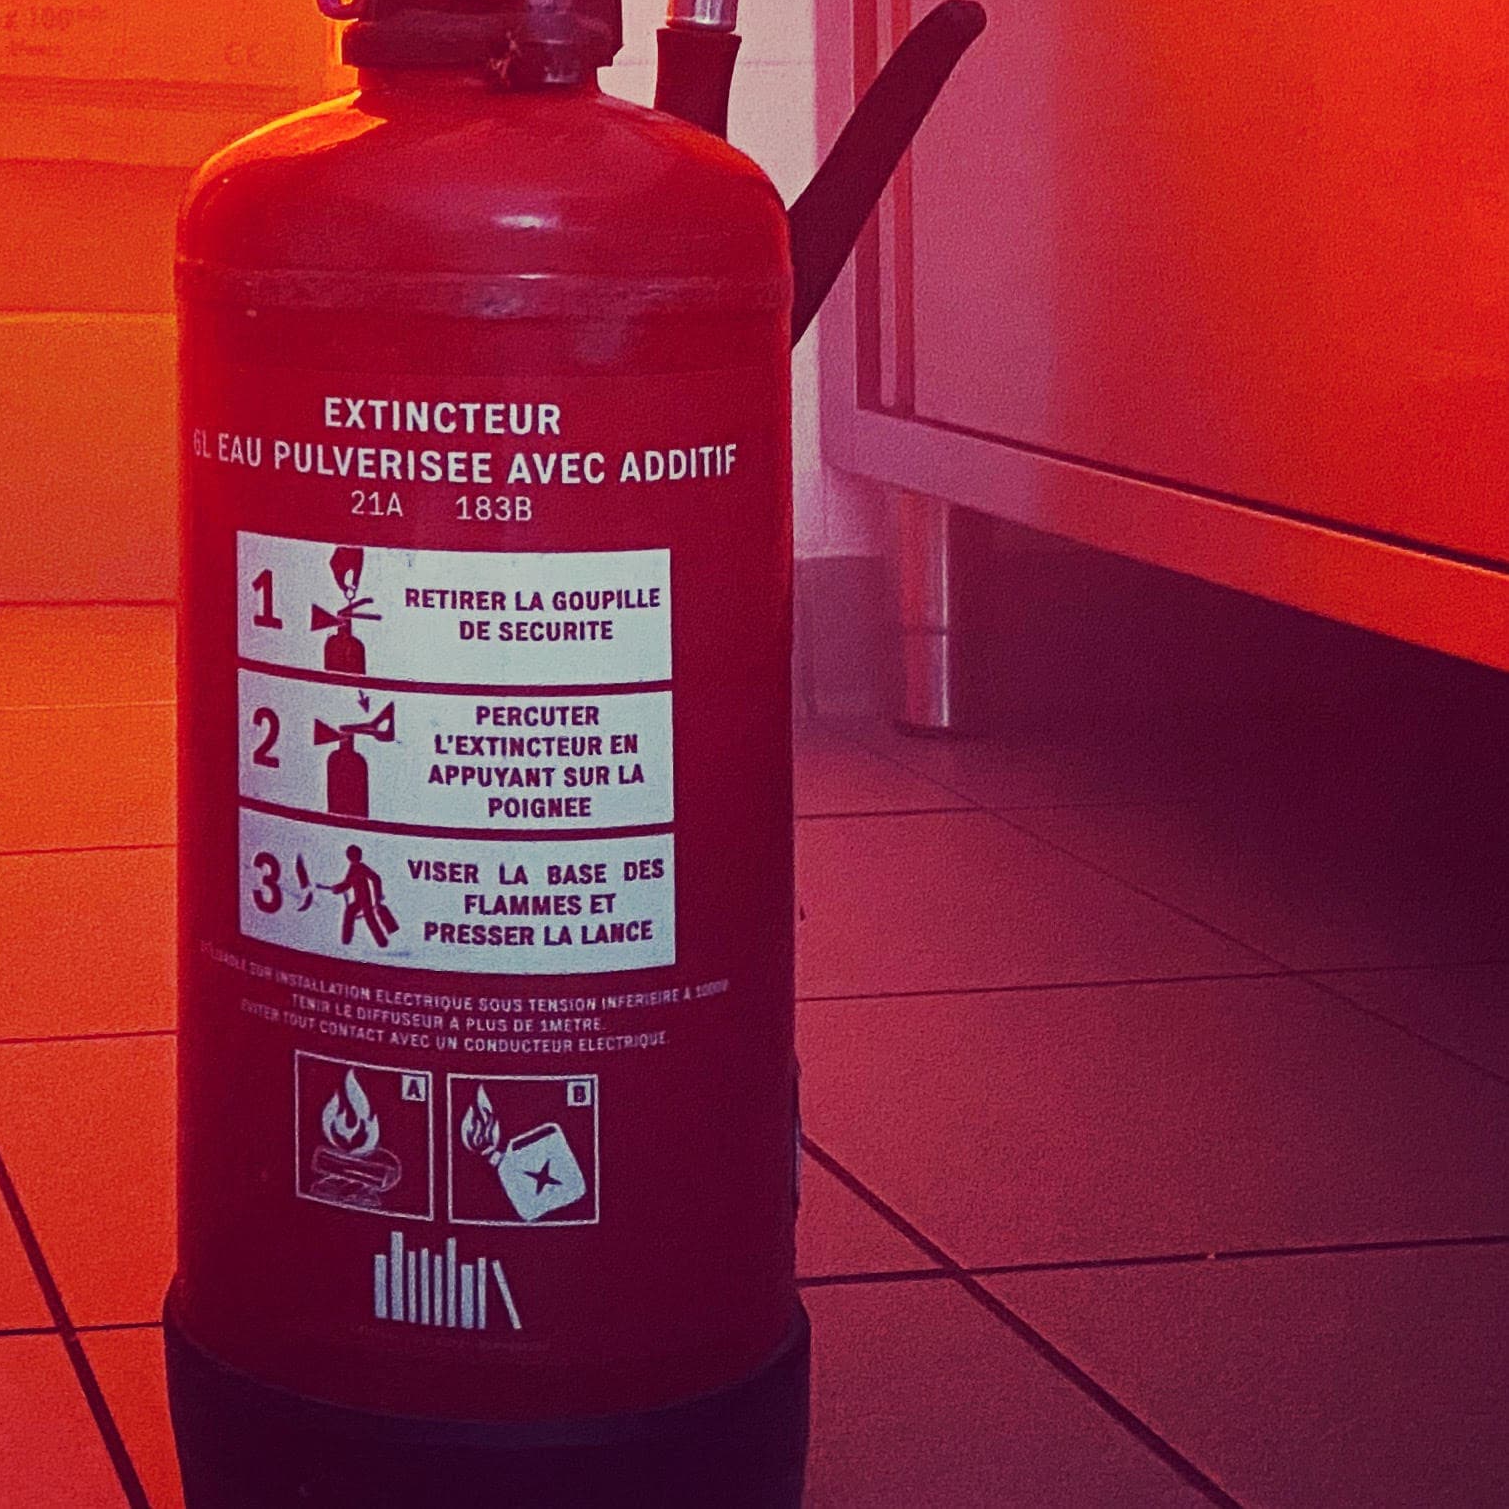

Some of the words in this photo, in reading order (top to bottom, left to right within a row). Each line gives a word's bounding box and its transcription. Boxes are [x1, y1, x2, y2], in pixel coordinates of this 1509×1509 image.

[324, 396, 561, 435] EXTINCTEUR
[193, 427, 212, 459] 6L
[218, 432, 262, 468] EAU
[273, 439, 493, 484] PULVERISEE
[507, 451, 606, 484] AVEC
[619, 442, 737, 483] ADDITIF
[350, 489, 404, 518] 21A
[455, 495, 533, 521] 183B
[252, 568, 283, 630] 1
[404, 587, 507, 611] RETIRER
[514, 590, 545, 612] LA
[551, 586, 661, 611] GOUPILLE
[458, 620, 491, 641] DE
[498, 619, 614, 642] SECURITE
[475, 705, 600, 727] PERCUTER
[252, 706, 280, 769] 2
[434, 733, 603, 758] L'EXTINCTEUR
[610, 733, 639, 755] EN
[427, 764, 556, 788] APPUYANT
[563, 765, 611, 788] SUR
[617, 763, 645, 785] LA
[487, 796, 592, 818] POIGNEE
[252, 851, 283, 914] 3
[407, 858, 480, 885] VISER
[498, 862, 529, 886] LA
[546, 862, 608, 886] BASE
[623, 857, 665, 882] DES
[464, 893, 583, 916] FLAMMES
[590, 892, 617, 915] ET
[423, 920, 535, 947] PRESSER
[543, 924, 573, 947] LA
[580, 919, 654, 946] LANCE
[275, 968, 371, 1001] INSTALLATION
[376, 988, 474, 1013] ELECTRIQUE
[478, 996, 524, 1013] SOUS
[527, 996, 597, 1013] TENSION
[240, 997, 281, 1023] EVITER
[283, 1009, 315, 1031] TOUT
[318, 1018, 384, 1043] CONTACT
[389, 1033, 430, 1050] AVEC
[435, 1036, 458, 1051] UN
[463, 1036, 574, 1054] CONDUCTEUR
[291, 993, 331, 1014] TENIR
[334, 1003, 353, 1019] LE
[356, 1005, 445, 1030] DIFFUSEUR
[448, 1016, 461, 1031] A
[465, 1016, 508, 1033] PLUS
[513, 1018, 534, 1033] DE
[406, 1078, 421, 1099] A
[573, 1084, 587, 1103] B
